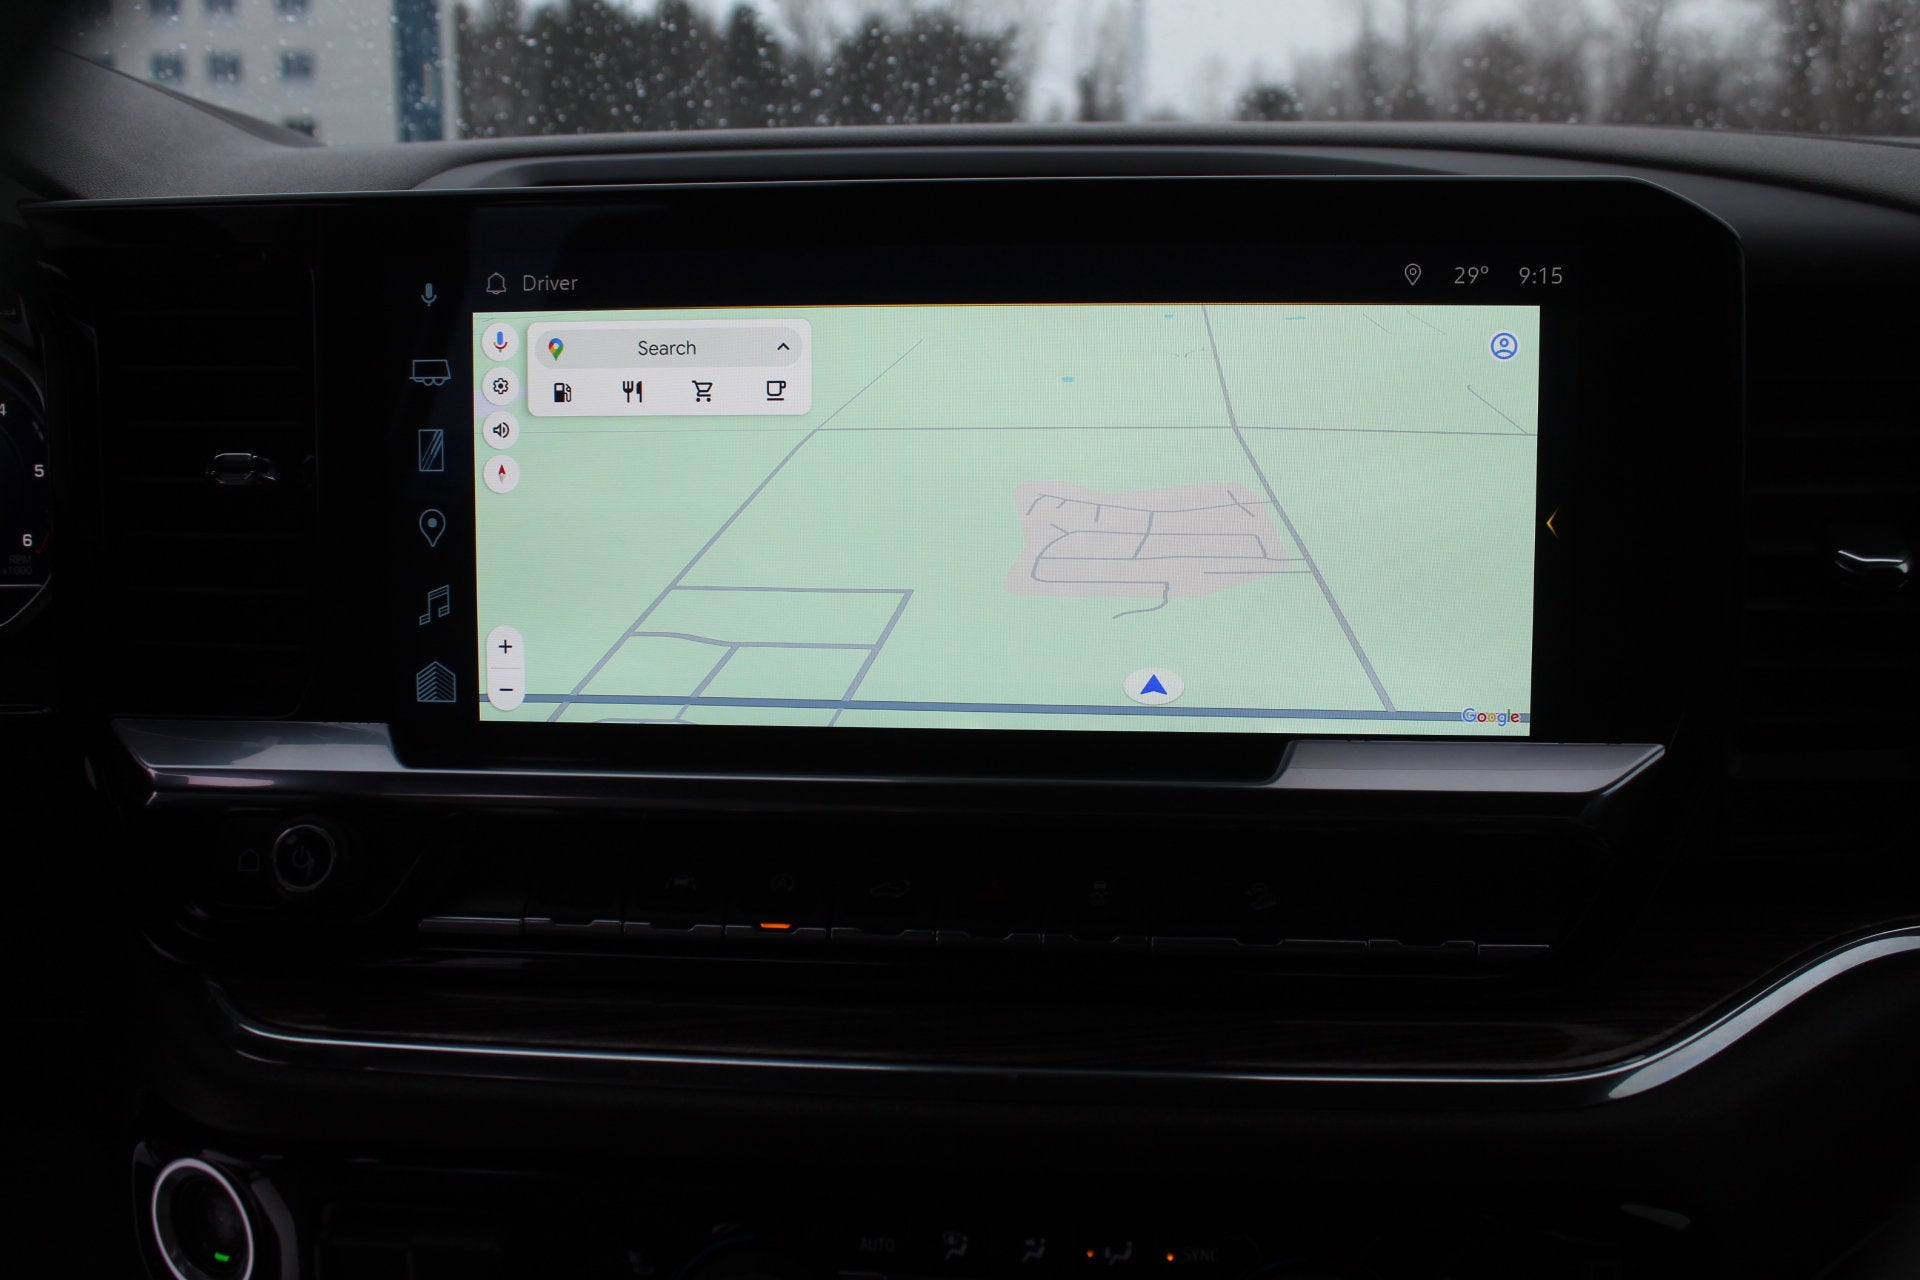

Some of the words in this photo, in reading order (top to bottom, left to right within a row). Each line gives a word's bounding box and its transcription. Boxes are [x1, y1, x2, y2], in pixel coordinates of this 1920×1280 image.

[523, 274, 579, 292] Driver
[1454, 265, 1489, 285] 29°
[1519, 266, 1563, 285] 9:15
[638, 340, 697, 356] Search
[0, 403, 7, 416] 4
[34, 464, 45, 478] 5
[22, 533, 33, 547] 6
[9, 554, 32, 565] RPM
[1462, 707, 1520, 727] Google
[859, 1236, 896, 1253] AUTO
[1183, 1247, 1220, 1263] SYNC
